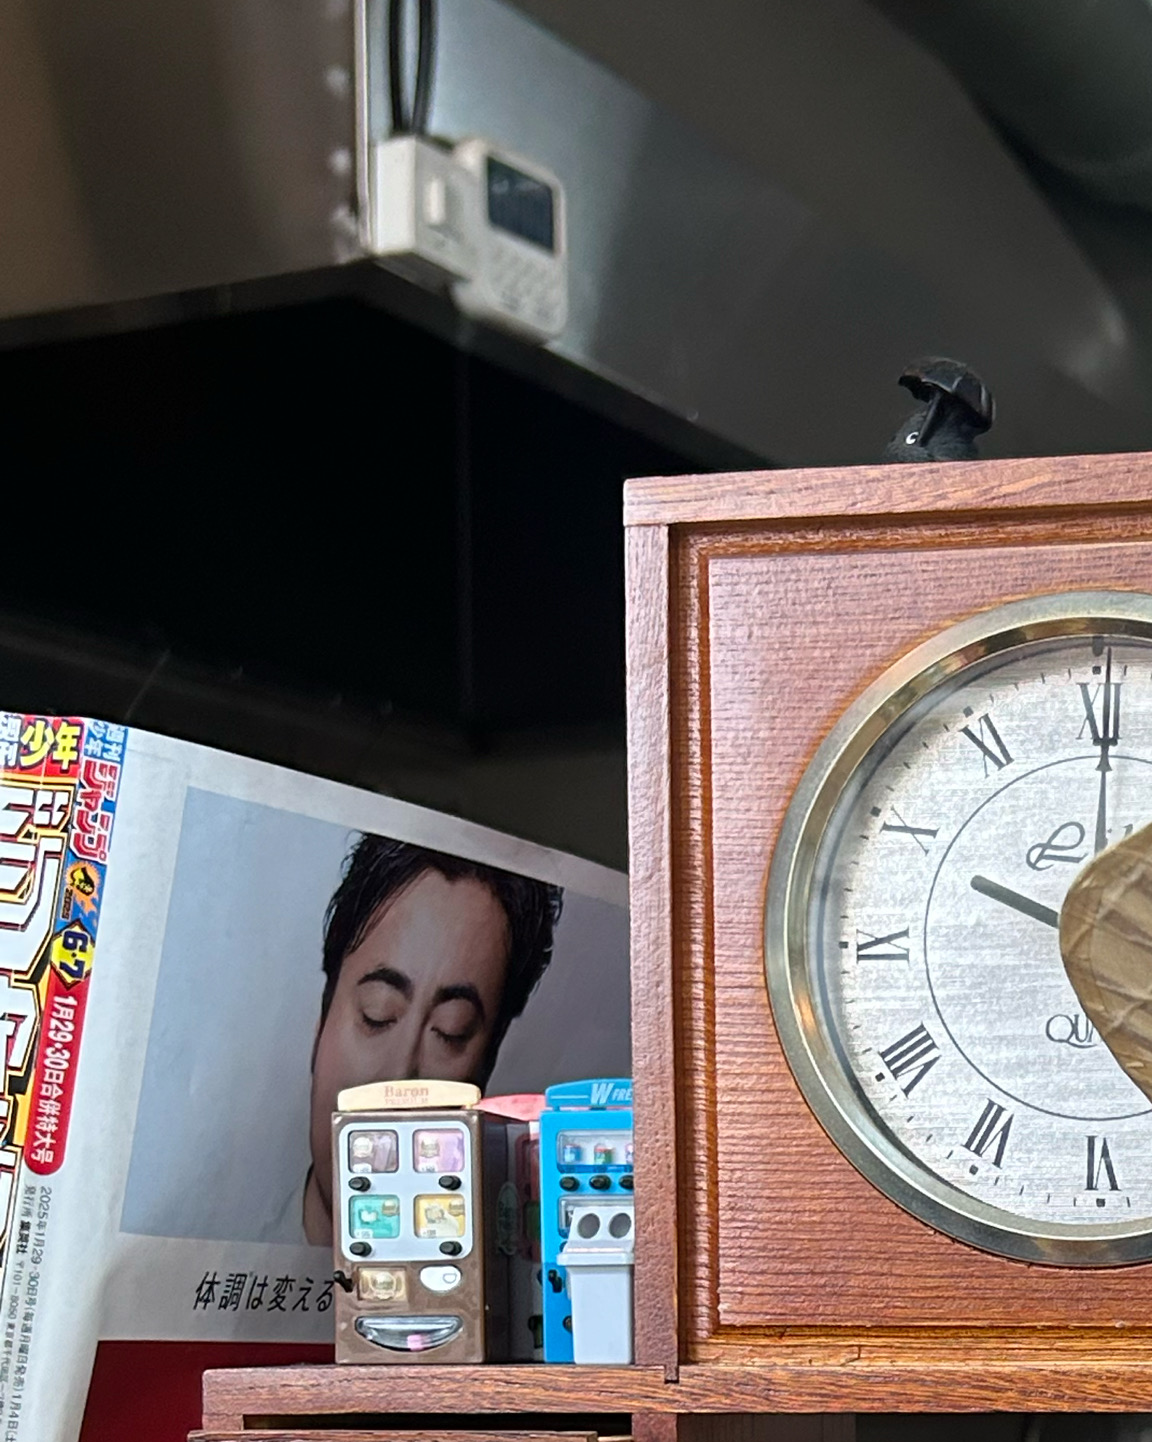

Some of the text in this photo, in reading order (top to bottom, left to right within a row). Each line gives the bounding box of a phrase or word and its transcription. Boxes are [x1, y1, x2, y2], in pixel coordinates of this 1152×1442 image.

[1076, 681, 1122, 740] XII
[20, 720, 81, 770] 少年
[959, 714, 1014, 777] XI
[70, 758, 121, 865] ジャンプ
[880, 807, 940, 855] X
[855, 927, 910, 963] IX
[879, 1023, 942, 1097] VIII
[962, 1098, 1016, 1170] VII
[1083, 1135, 1121, 1192] VI
[193, 1271, 335, 1312] 体調は変える
